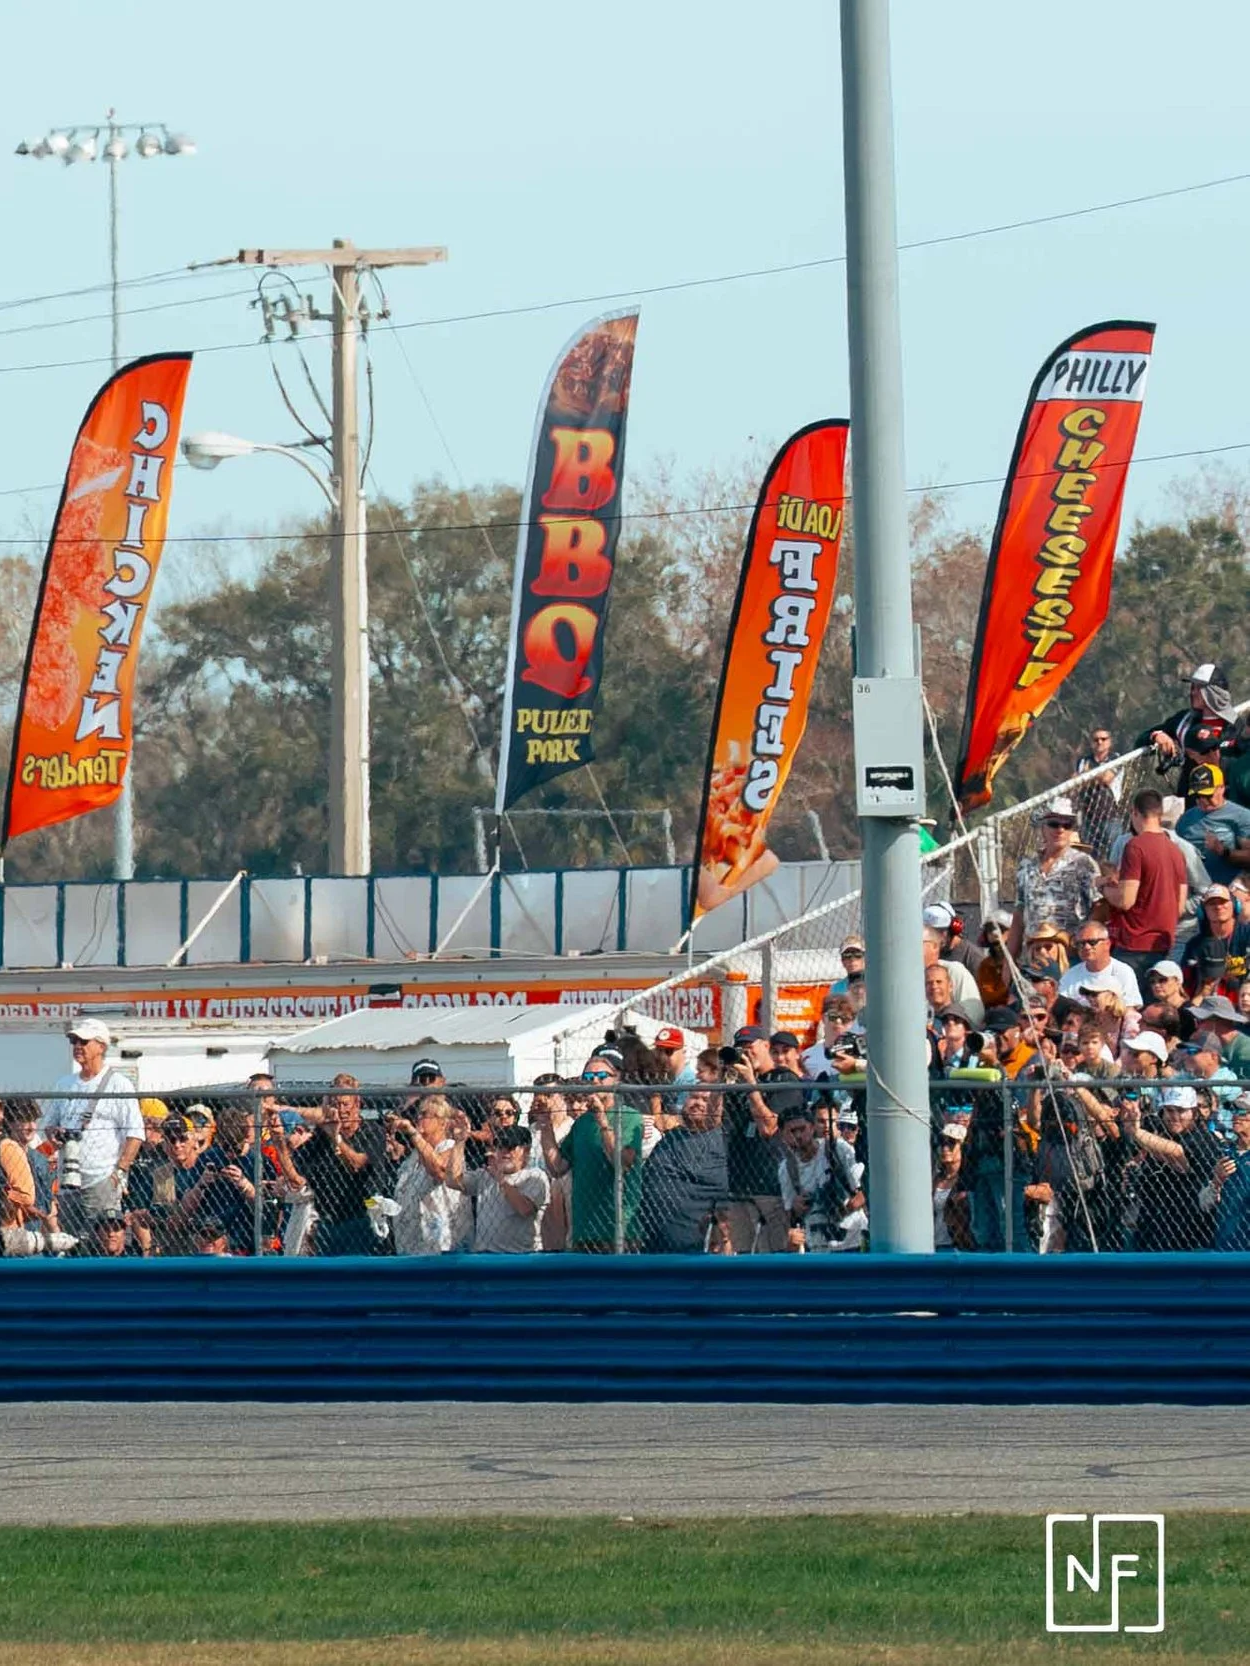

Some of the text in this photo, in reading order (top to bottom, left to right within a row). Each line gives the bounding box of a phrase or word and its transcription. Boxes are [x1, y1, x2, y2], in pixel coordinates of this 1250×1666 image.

[1053, 357, 1148, 396] PHILLY
[520, 426, 617, 698] BBQ
[857, 683, 871, 694] 36
[37, 1002, 82, 1018] FRIE
